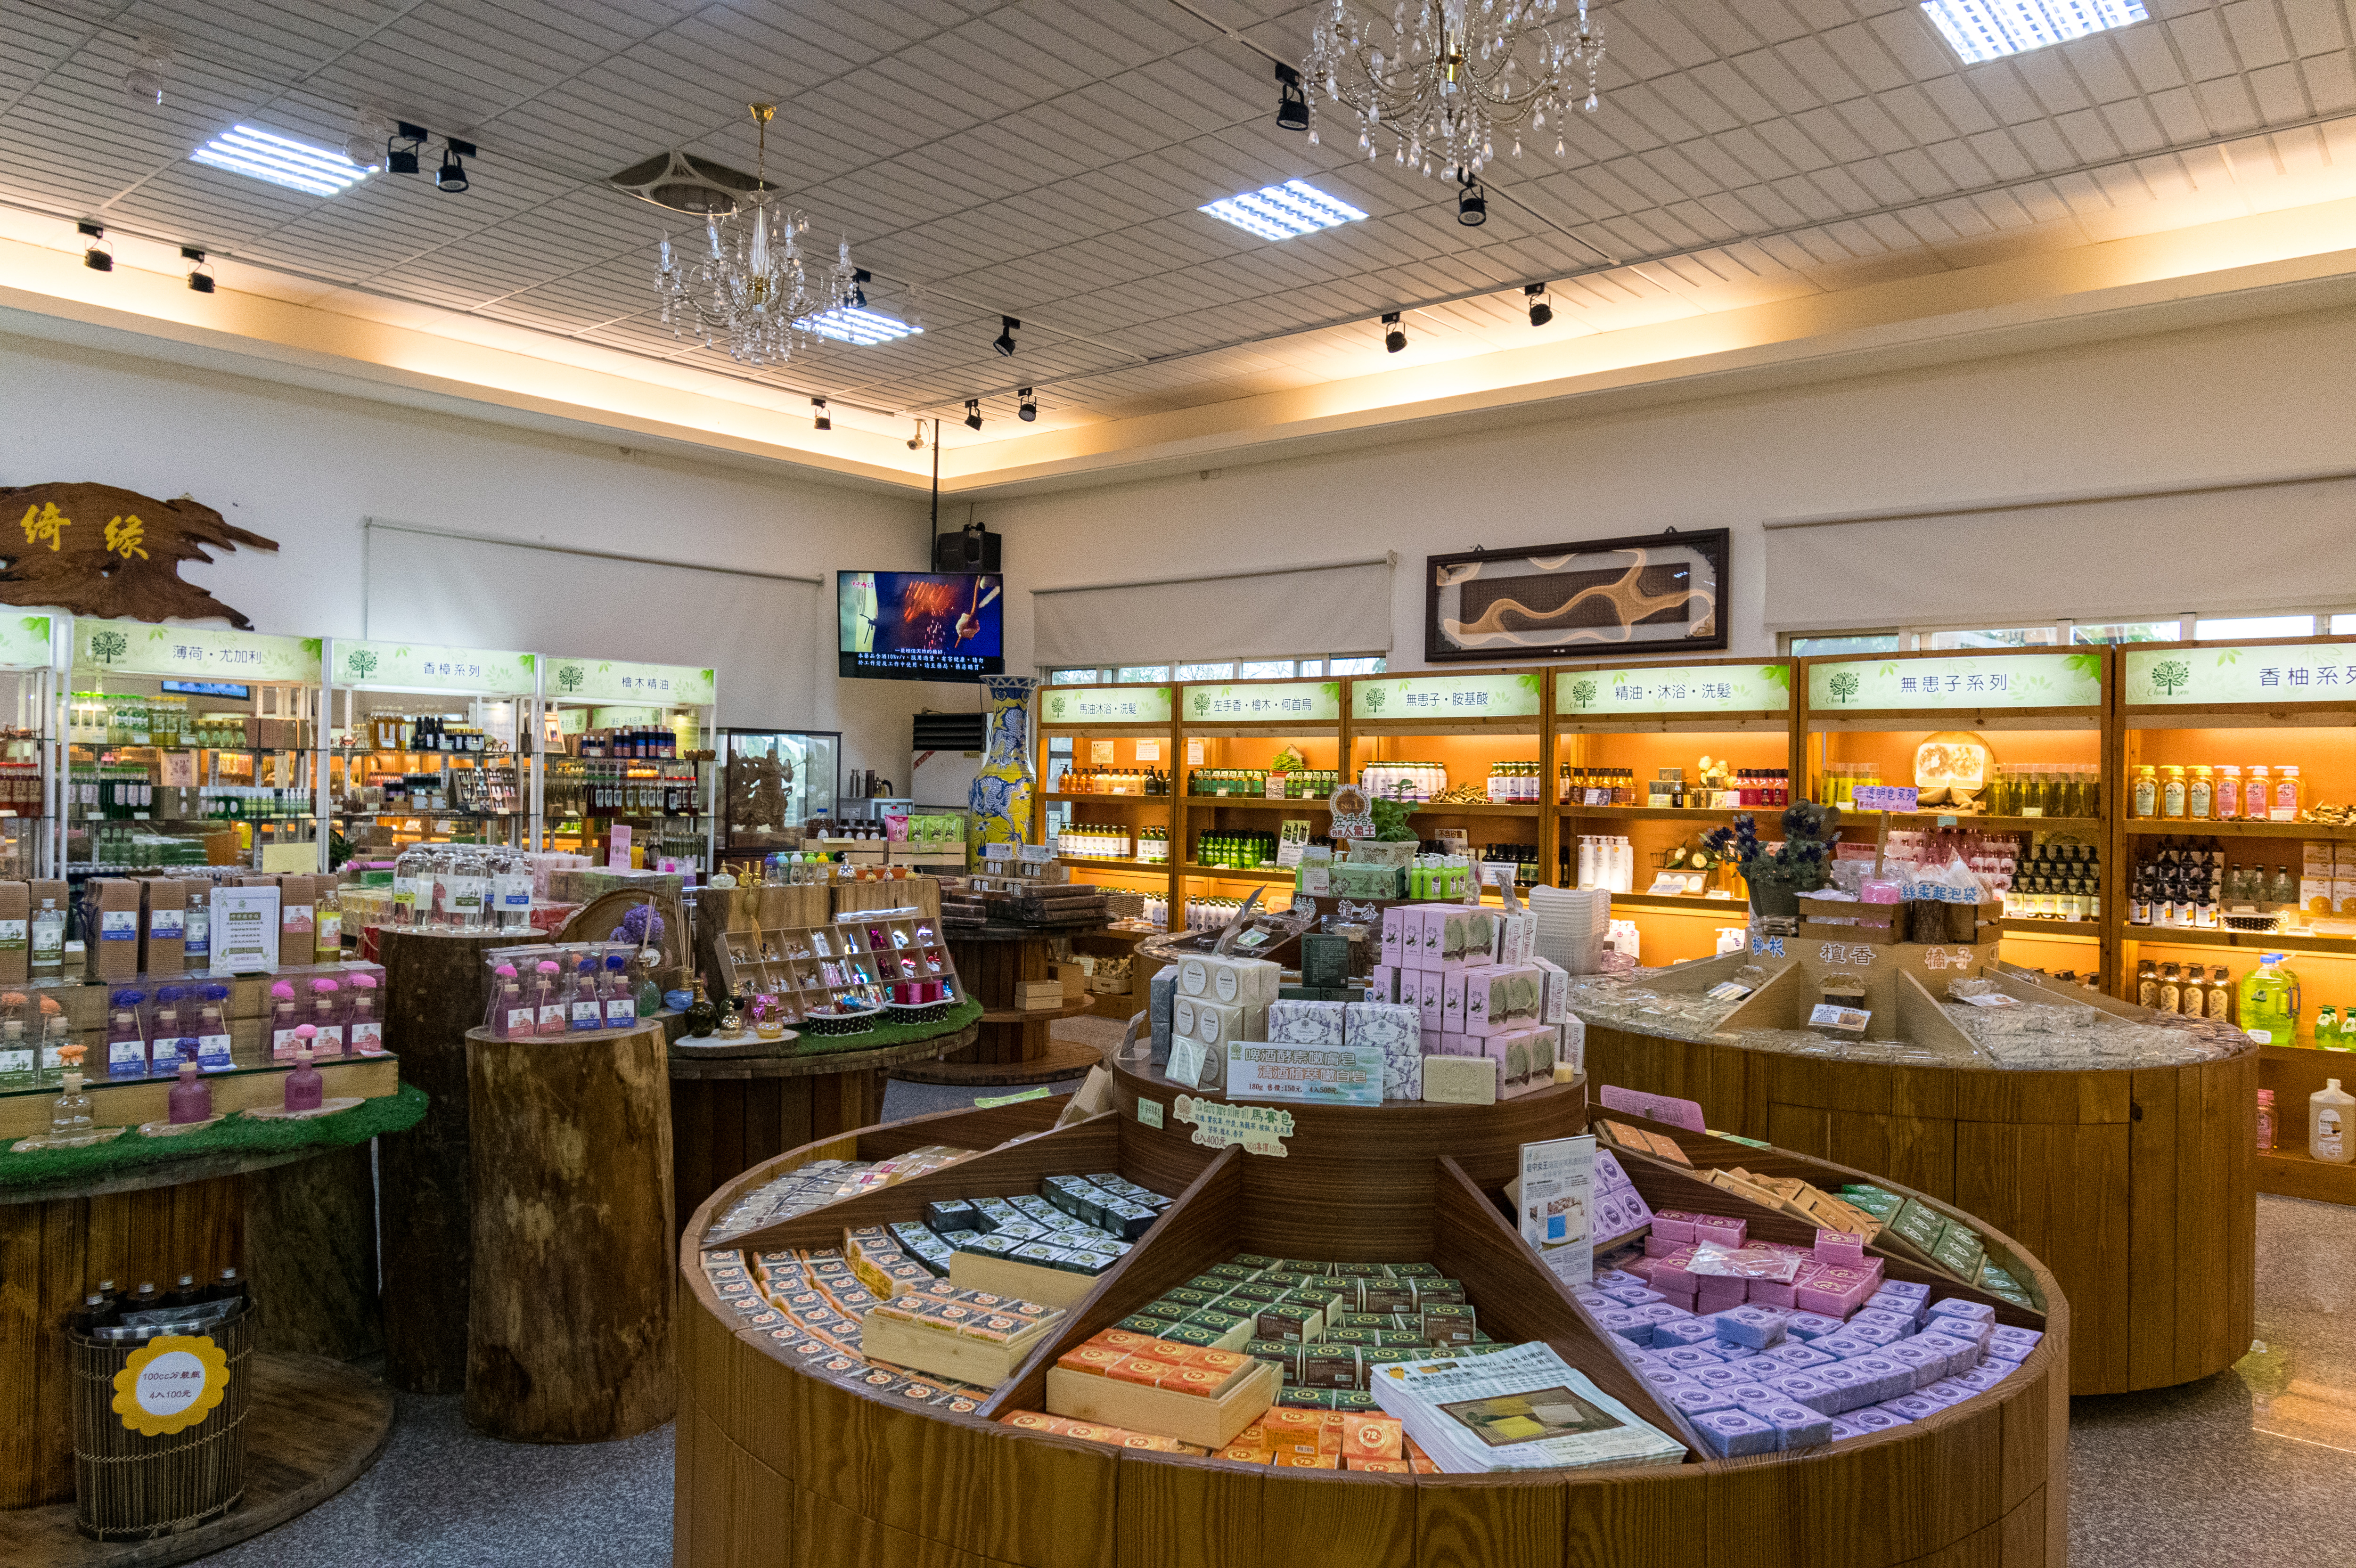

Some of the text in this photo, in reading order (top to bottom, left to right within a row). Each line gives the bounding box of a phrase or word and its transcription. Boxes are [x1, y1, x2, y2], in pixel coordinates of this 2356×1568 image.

[423, 662, 481, 678] 香樟系列
[622, 676, 670, 691] 檜木精油
[1901, 674, 2007, 693] 無患子系列
[1334, 813, 1371, 827] 左手香
[1901, 883, 1977, 901] 絲柔起泡袋
[1339, 900, 1378, 916] 檜木
[1820, 943, 1876, 965] 檀香
[1924, 947, 1973, 970] 橘子
[1245, 1048, 1356, 1067] 啤酒酵素嫩膚皂
[1258, 1065, 1367, 1084] 清酒植萃嫩白皂
[1249, 1083, 1263, 1092] 180g
[1251, 1109, 1293, 1127] 馬賽皂
